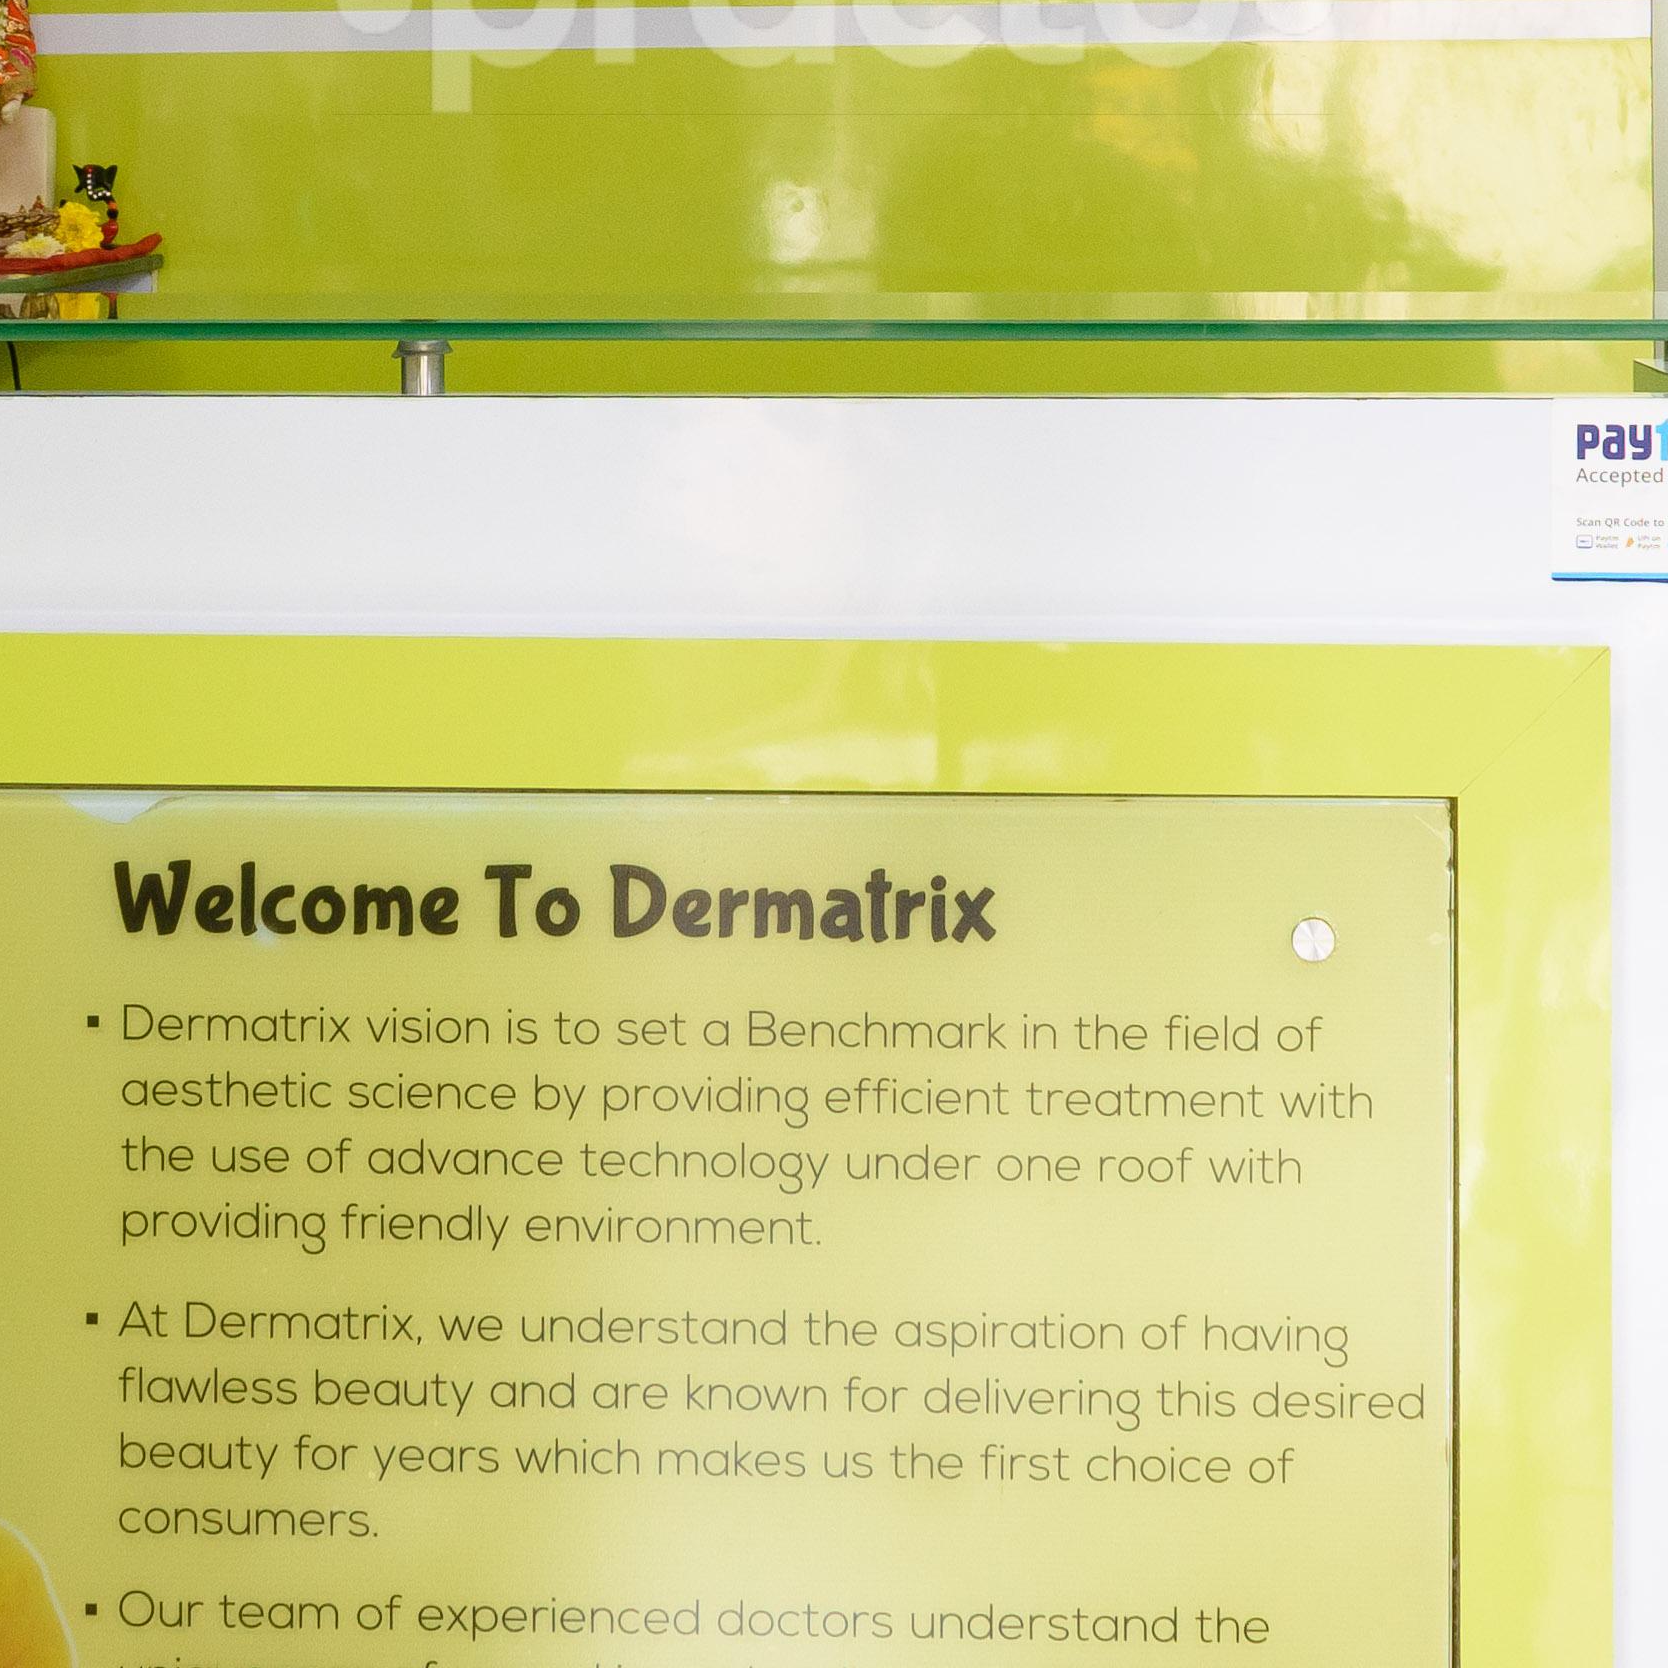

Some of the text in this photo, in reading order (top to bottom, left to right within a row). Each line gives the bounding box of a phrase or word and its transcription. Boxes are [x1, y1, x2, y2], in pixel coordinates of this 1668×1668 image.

[1576, 468, 1664, 487] Accepted
[1576, 517, 1601, 528] Scan
[1604, 517, 1620, 529] QR
[1623, 517, 1650, 528] Code
[1653, 518, 1665, 528] to
[114, 860, 996, 943] Welcome To Dermatrix
[123, 1004, 1323, 1052] Dermatrix vision is to set a Benchmark in the field of
[122, 1071, 1372, 1129] aesthetic science by providing efficient treatment with
[122, 1136, 1301, 1195] the use of advance technology under one roof with
[122, 1202, 820, 1255] providing friendly environment.
[118, 1301, 1348, 1368] At Dermatrix, we understand the aspiration of having
[119, 1366, 1424, 1432] flawless beauty and are known for delivering this desired
[120, 1432, 1294, 1484] beauty for years which makes us the first choice of
[119, 1507, 378, 1537] consumers.
[119, 1590, 1269, 1644] Our team of experienced doctors understand the
